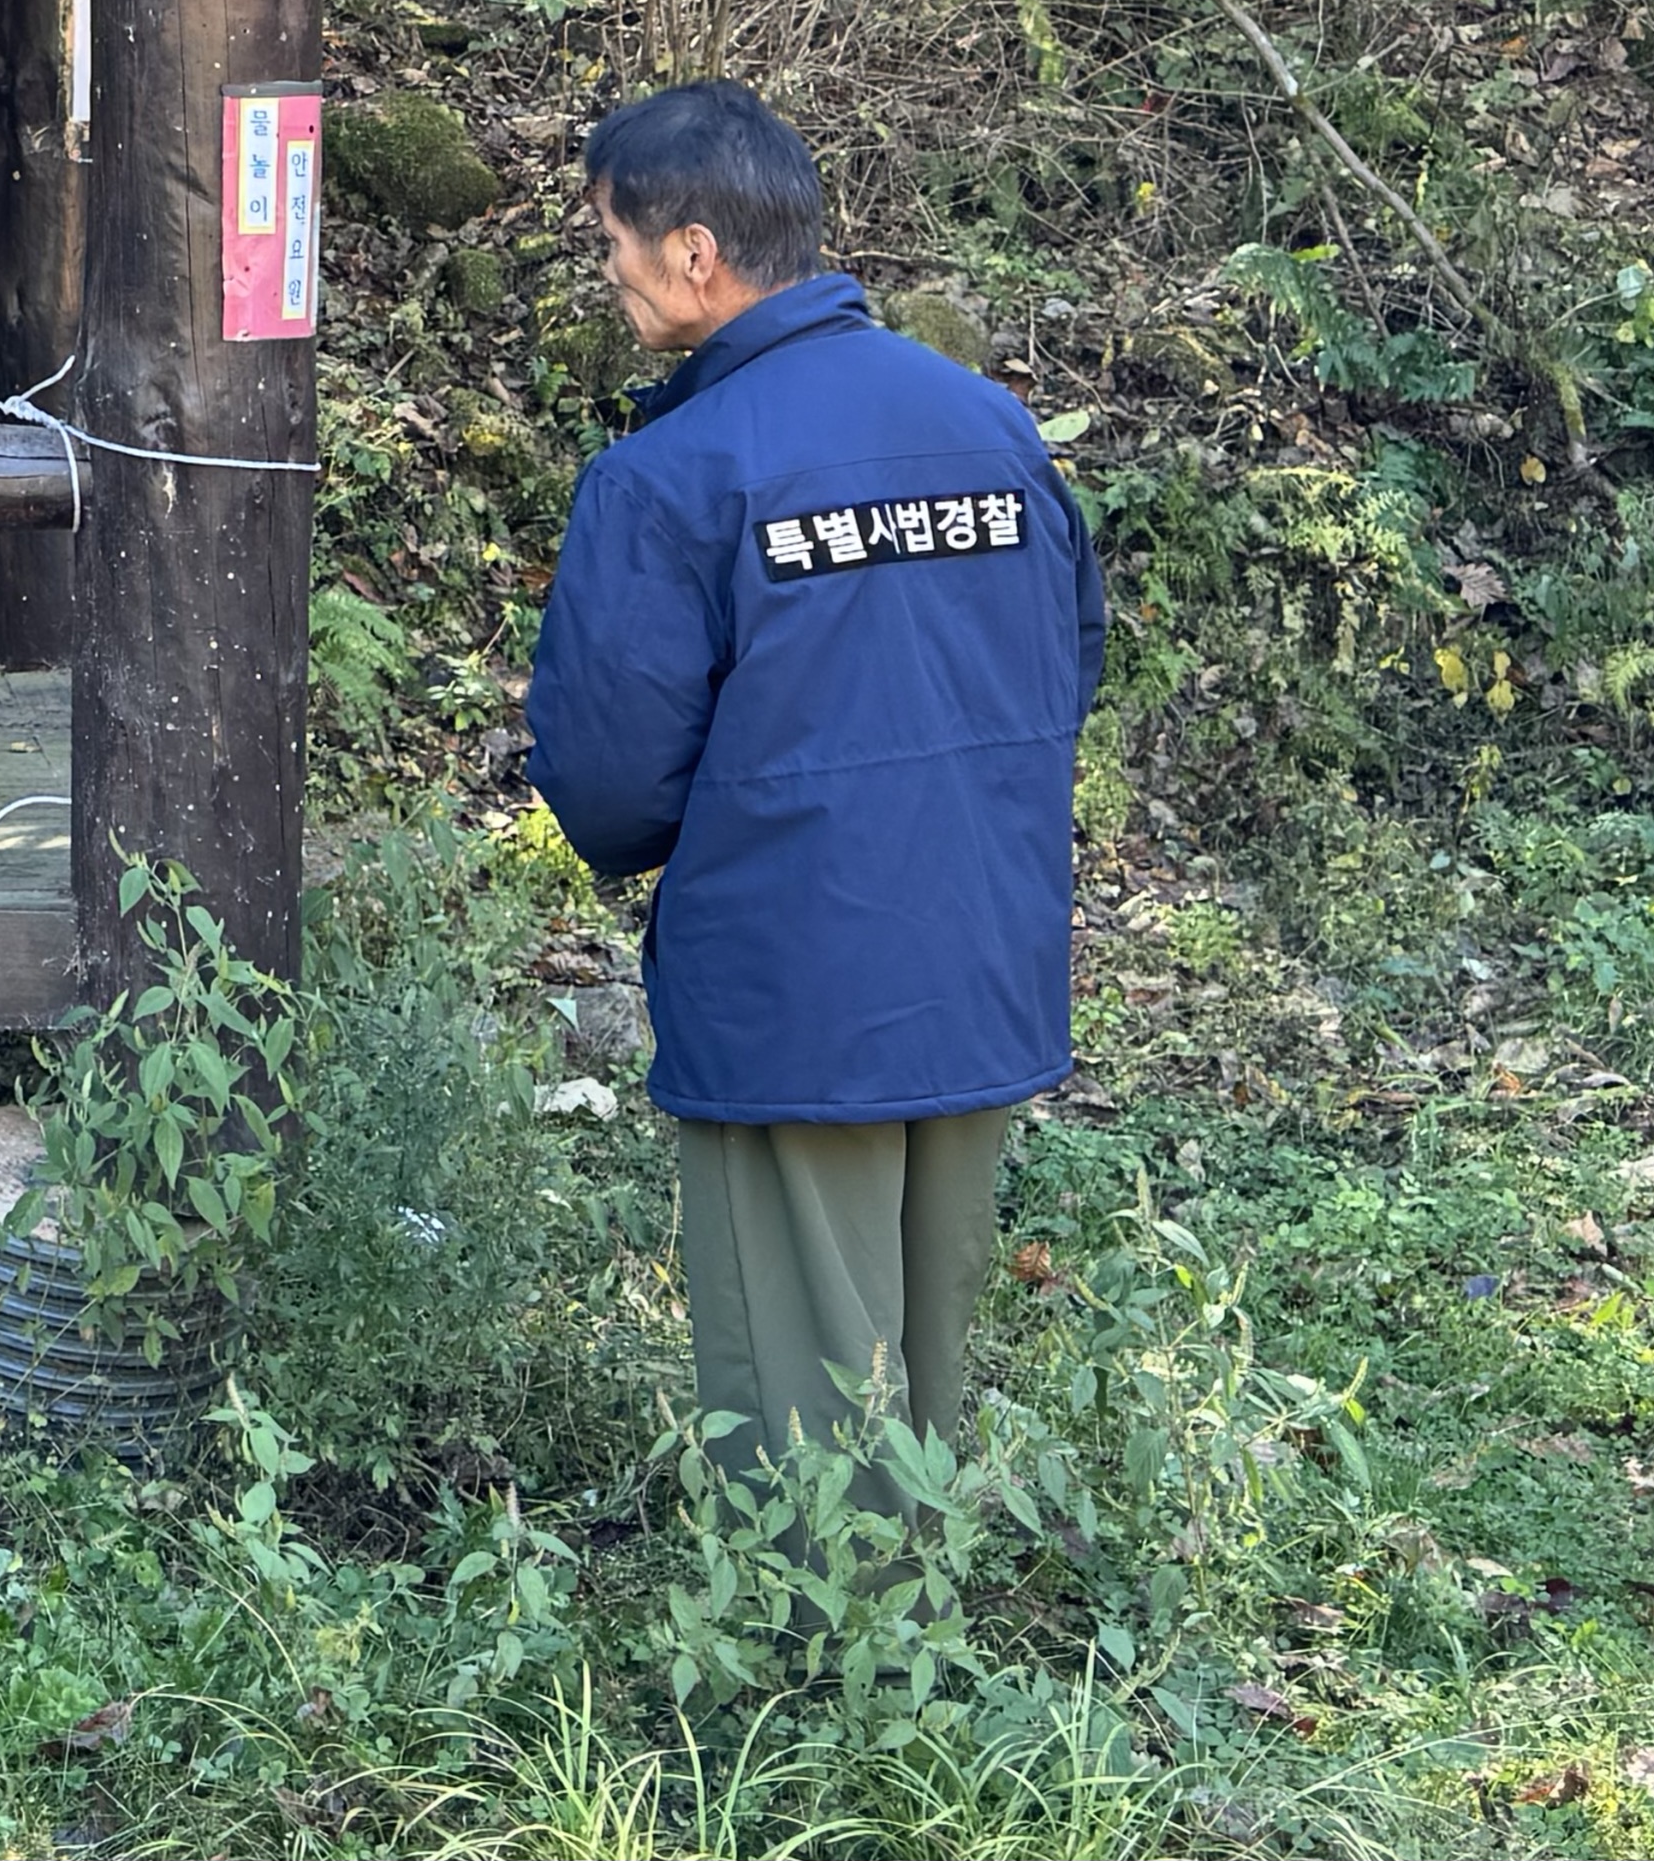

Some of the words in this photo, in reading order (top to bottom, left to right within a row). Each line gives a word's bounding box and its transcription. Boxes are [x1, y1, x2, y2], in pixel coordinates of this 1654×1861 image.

[250, 109, 271, 222] 물놀이
[288, 152, 308, 306] 안전요원
[766, 493, 1023, 571] 특별사법경찰
